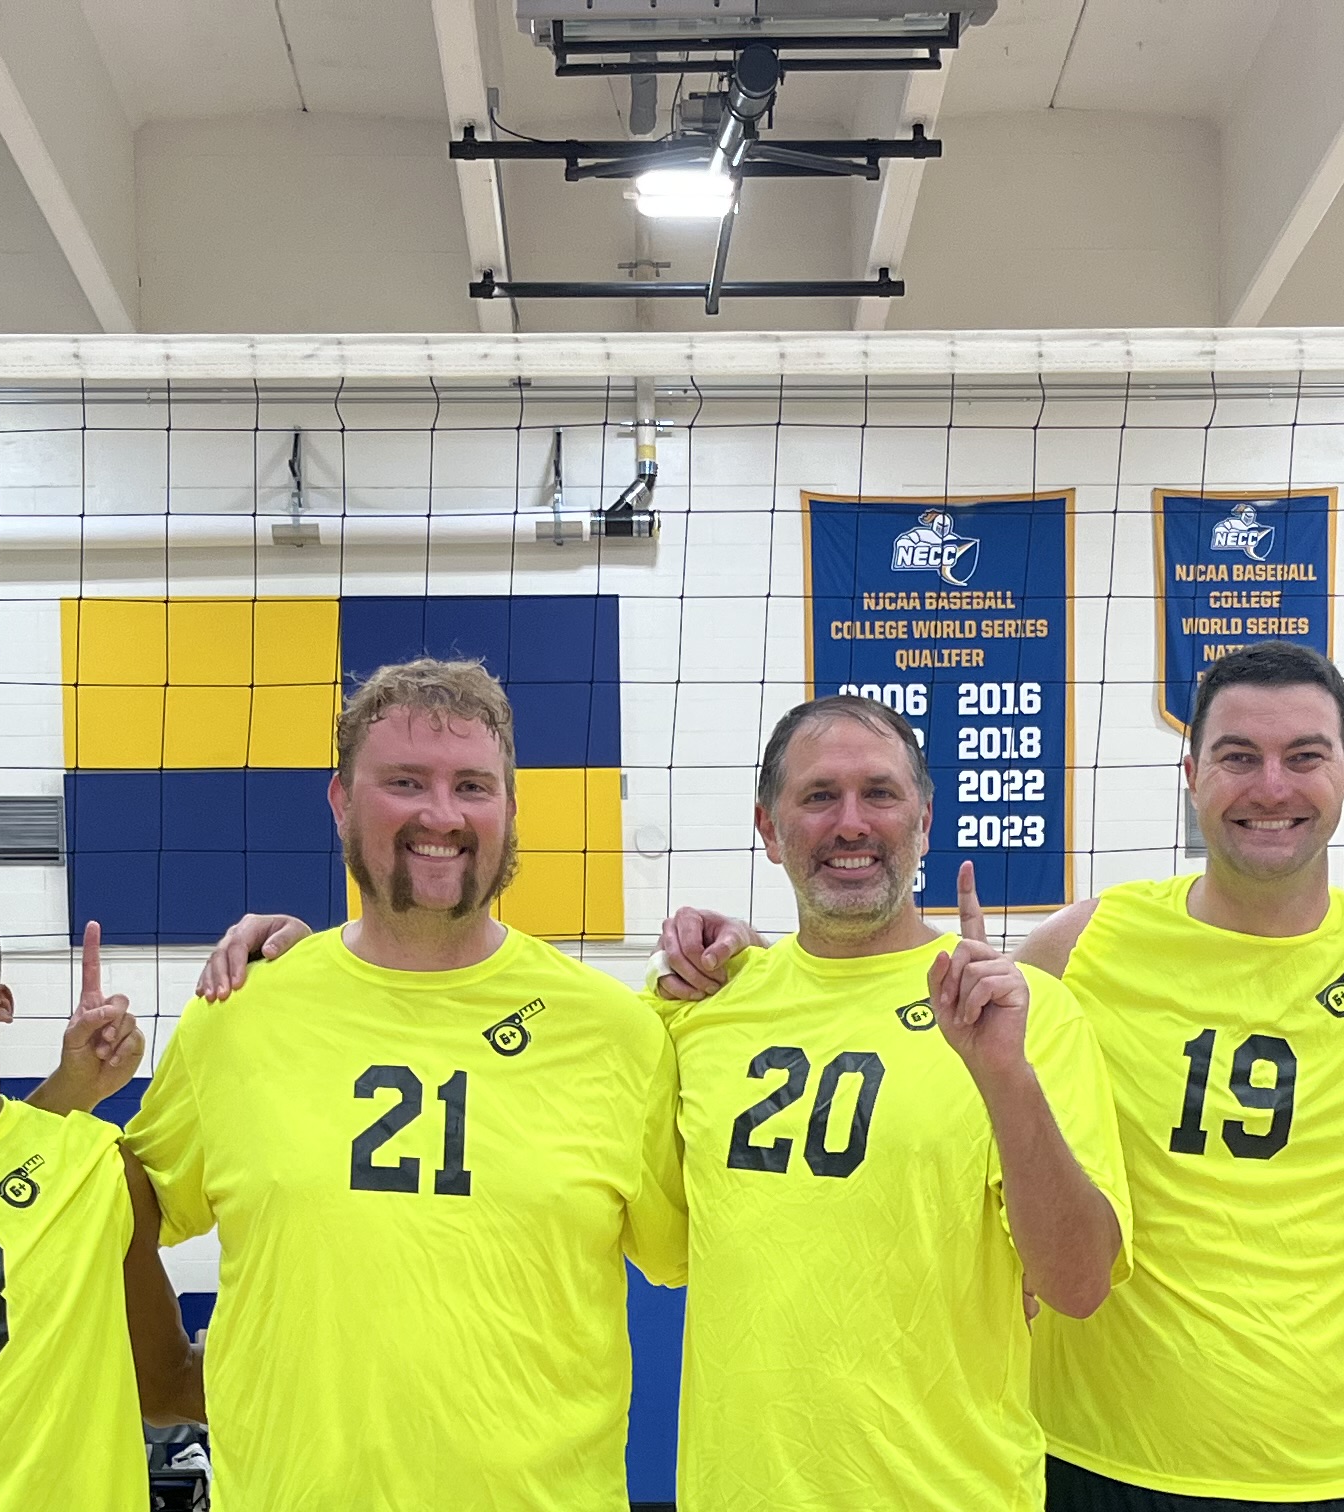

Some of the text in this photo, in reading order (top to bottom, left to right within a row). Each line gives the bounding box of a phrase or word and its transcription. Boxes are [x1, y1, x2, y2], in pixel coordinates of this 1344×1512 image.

[1214, 532, 1258, 547] NECC
[895, 545, 958, 569] NECC
[1175, 563, 1317, 582] NJCAA BASEBALL
[863, 591, 1015, 610] NJCAA BASEBALL
[1209, 590, 1282, 609] COLLEGE
[830, 619, 1049, 640] COLLEGE WORLD SERIES
[1182, 617, 1309, 635] WORLD SERIES
[895, 649, 985, 671] QUALIFER
[958, 682, 1042, 715] 2016
[958, 726, 1042, 760] 2018
[958, 769, 1045, 803] 2022
[957, 815, 1045, 849] 2023
[1169, 1028, 1298, 1160] 19
[727, 1046, 885, 1178] 20
[350, 1065, 472, 1196] 21
